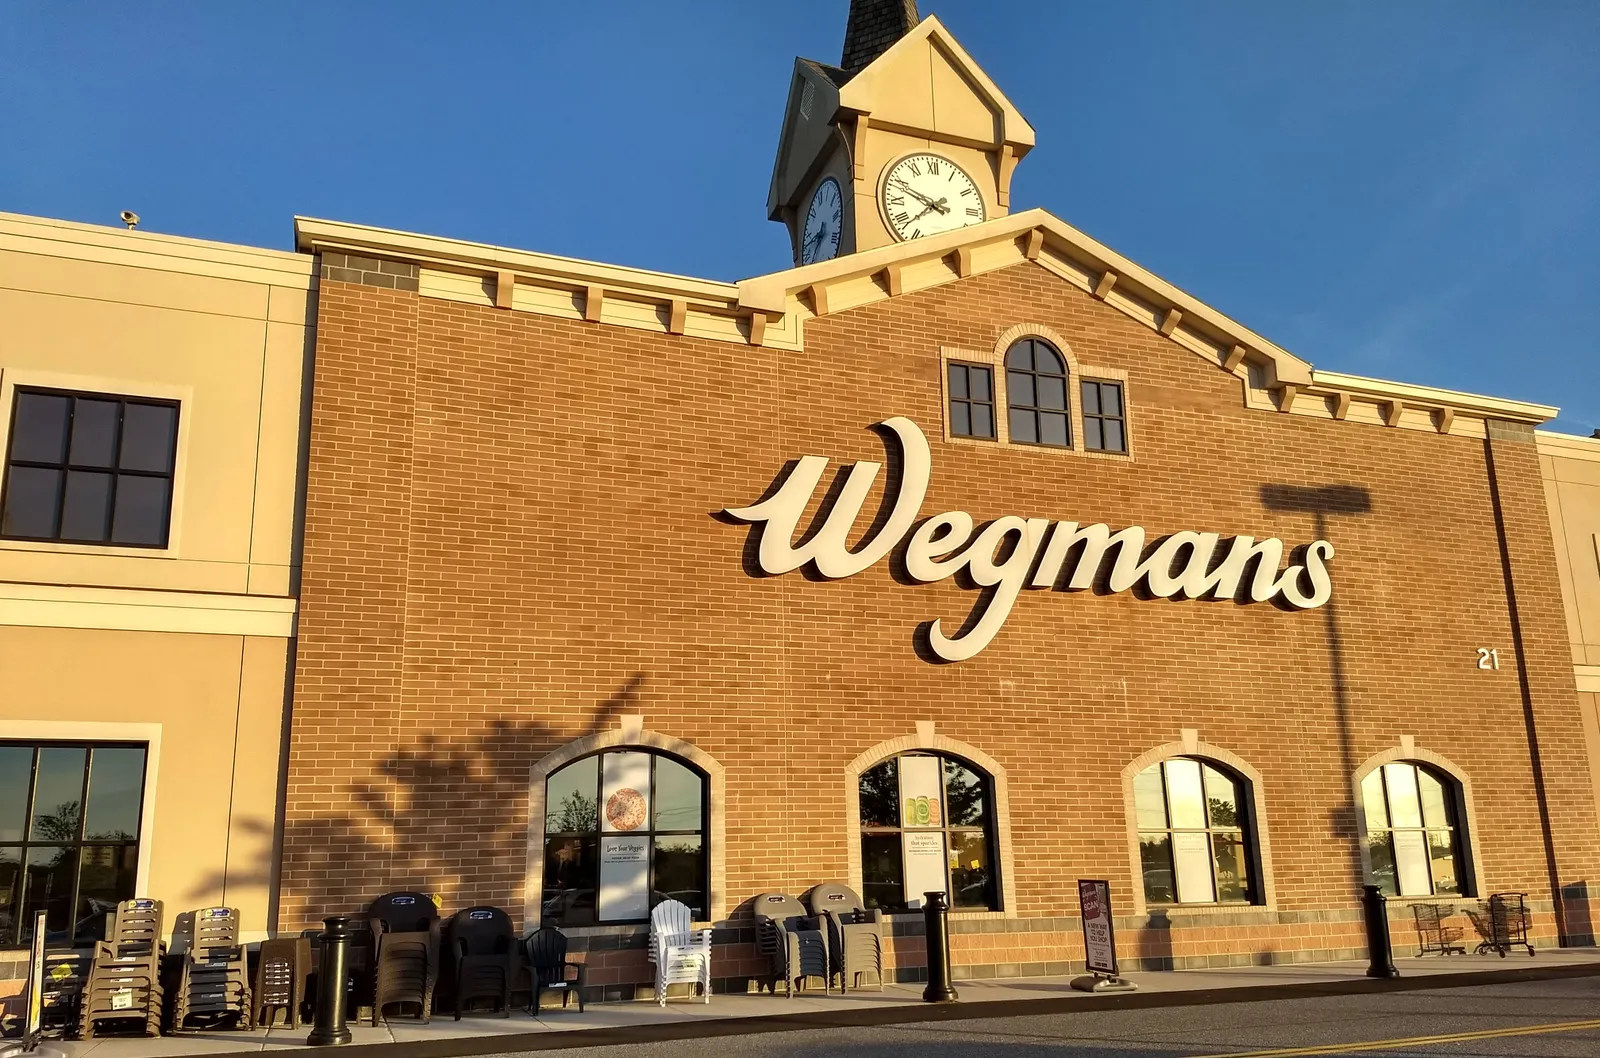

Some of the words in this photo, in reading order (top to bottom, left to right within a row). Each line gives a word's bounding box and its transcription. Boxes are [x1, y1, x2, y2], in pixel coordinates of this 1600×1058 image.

[926, 160, 939, 175] XII
[720, 416, 1336, 662] Wegmans
[1476, 647, 1499, 670] 21
[1084, 901, 1098, 911] SCAN
